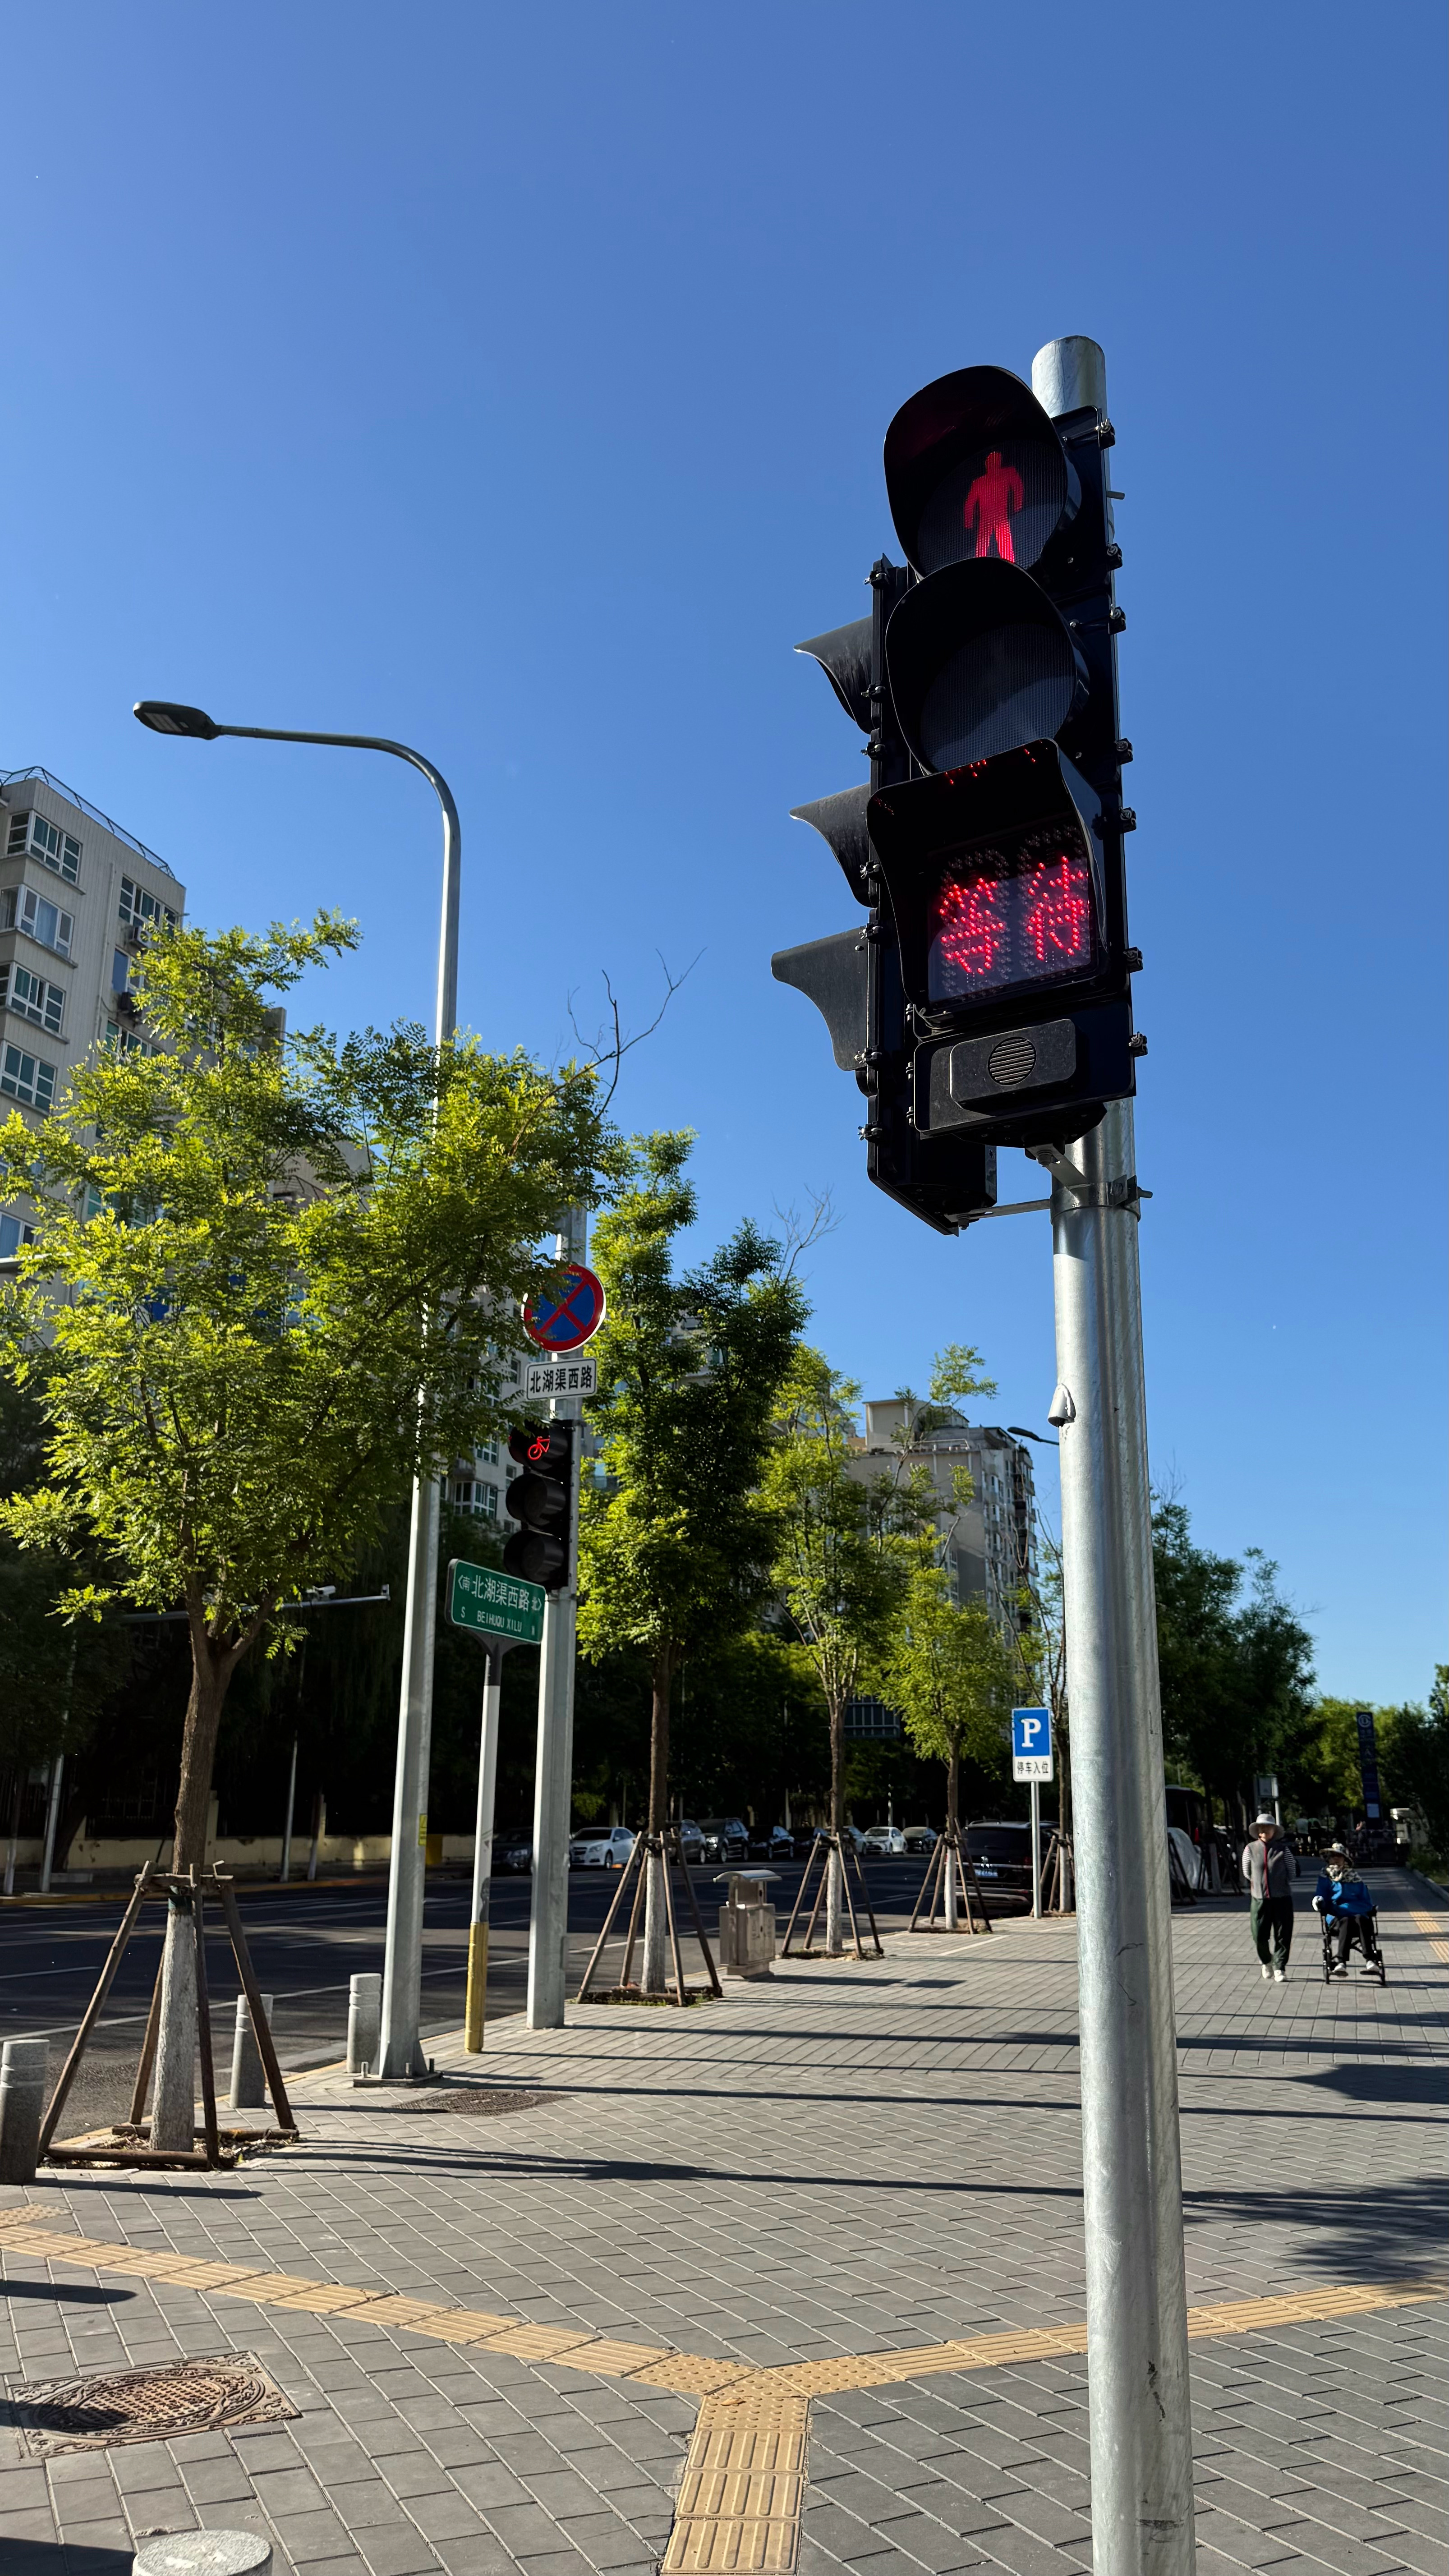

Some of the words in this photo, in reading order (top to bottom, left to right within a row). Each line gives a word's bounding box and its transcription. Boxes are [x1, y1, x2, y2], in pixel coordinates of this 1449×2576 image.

[939, 856, 1088, 975] 等待
[530, 1365, 592, 1393] 北湖渠西路
[462, 1576, 470, 1592] 南
[471, 1574, 530, 1612] 北湖渠西路
[460, 1606, 466, 1619] S
[477, 1610, 505, 1628] BEIHUQU
[1021, 1718, 1042, 1748] P
[1017, 1761, 1049, 1774] 停车入位
